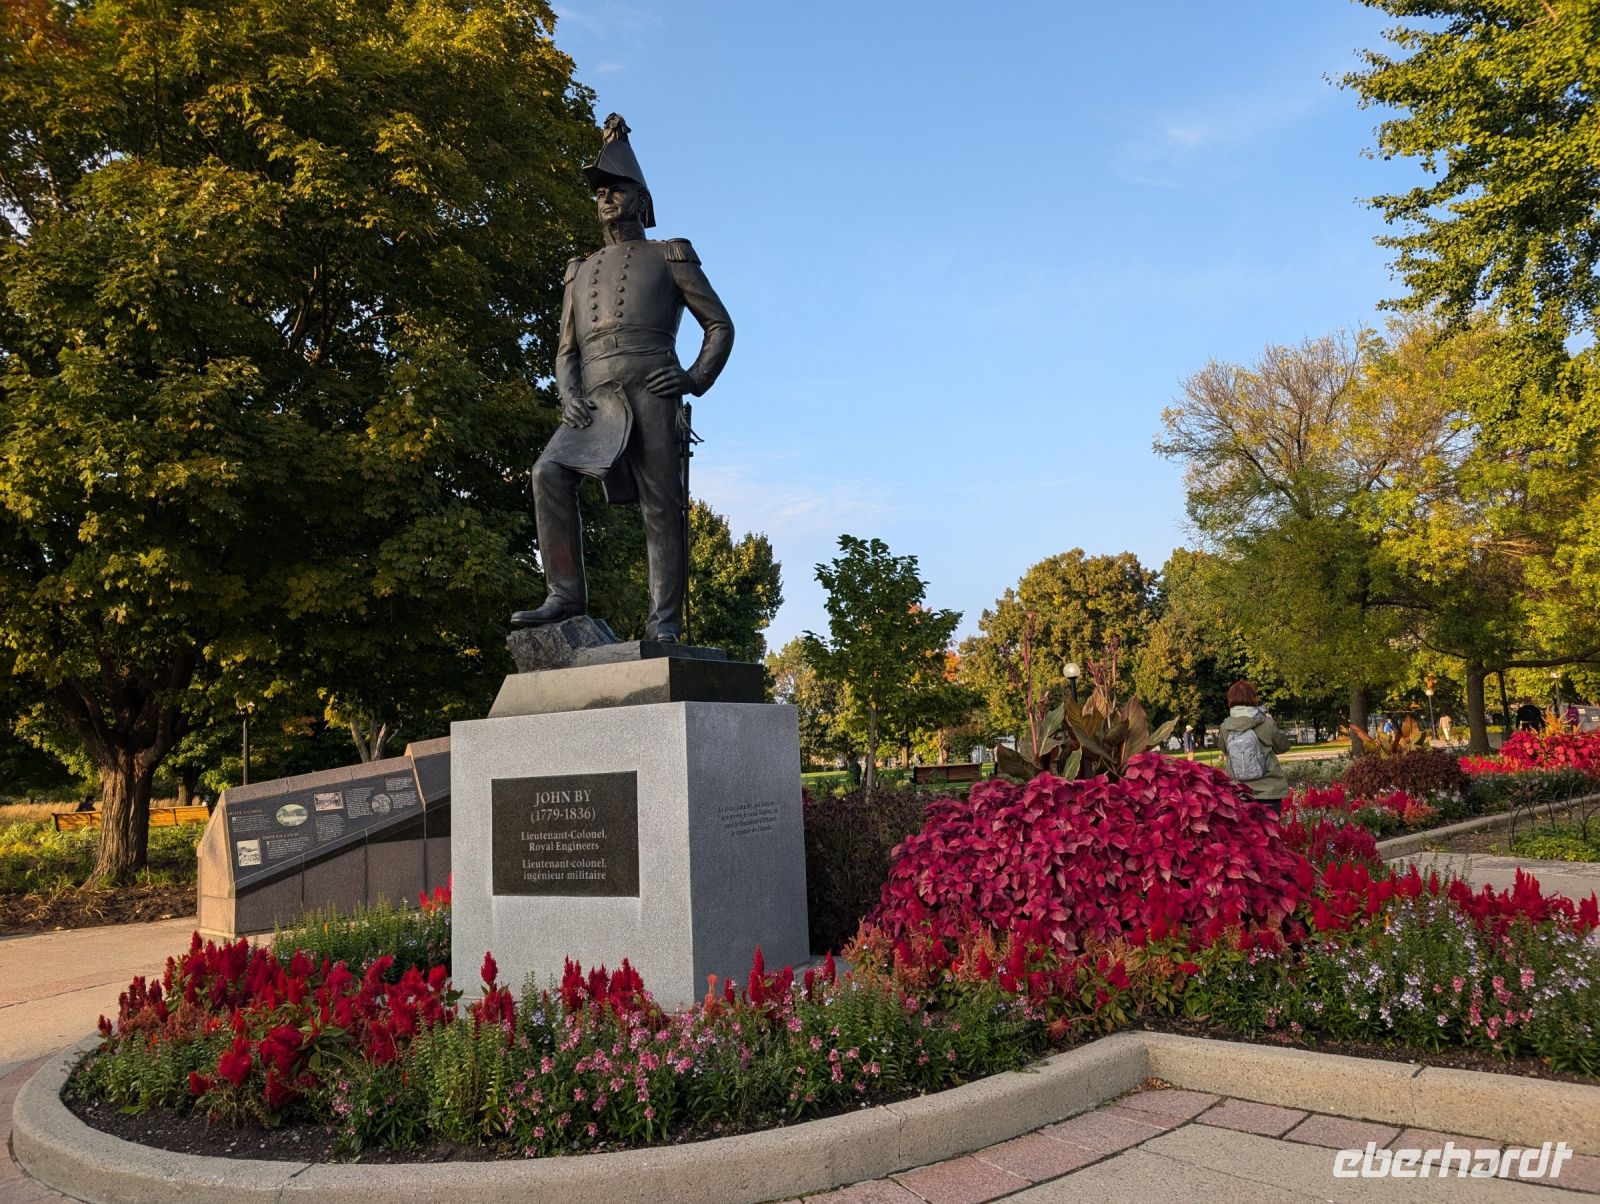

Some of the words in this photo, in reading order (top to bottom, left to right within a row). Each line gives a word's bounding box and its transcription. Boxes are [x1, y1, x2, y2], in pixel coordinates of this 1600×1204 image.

[533, 791, 571, 807] JOHN
[574, 790, 592, 803] BY
[530, 807, 596, 823] (1779-1836)
[521, 829, 607, 840] Lieutenant-Colonel,
[529, 841, 554, 853] Royal
[556, 841, 599, 852] Engineers
[522, 859, 607, 869] Lieutenant-colonel,
[523, 871, 565, 882] ingénieur
[567, 870, 606, 880] militaire
